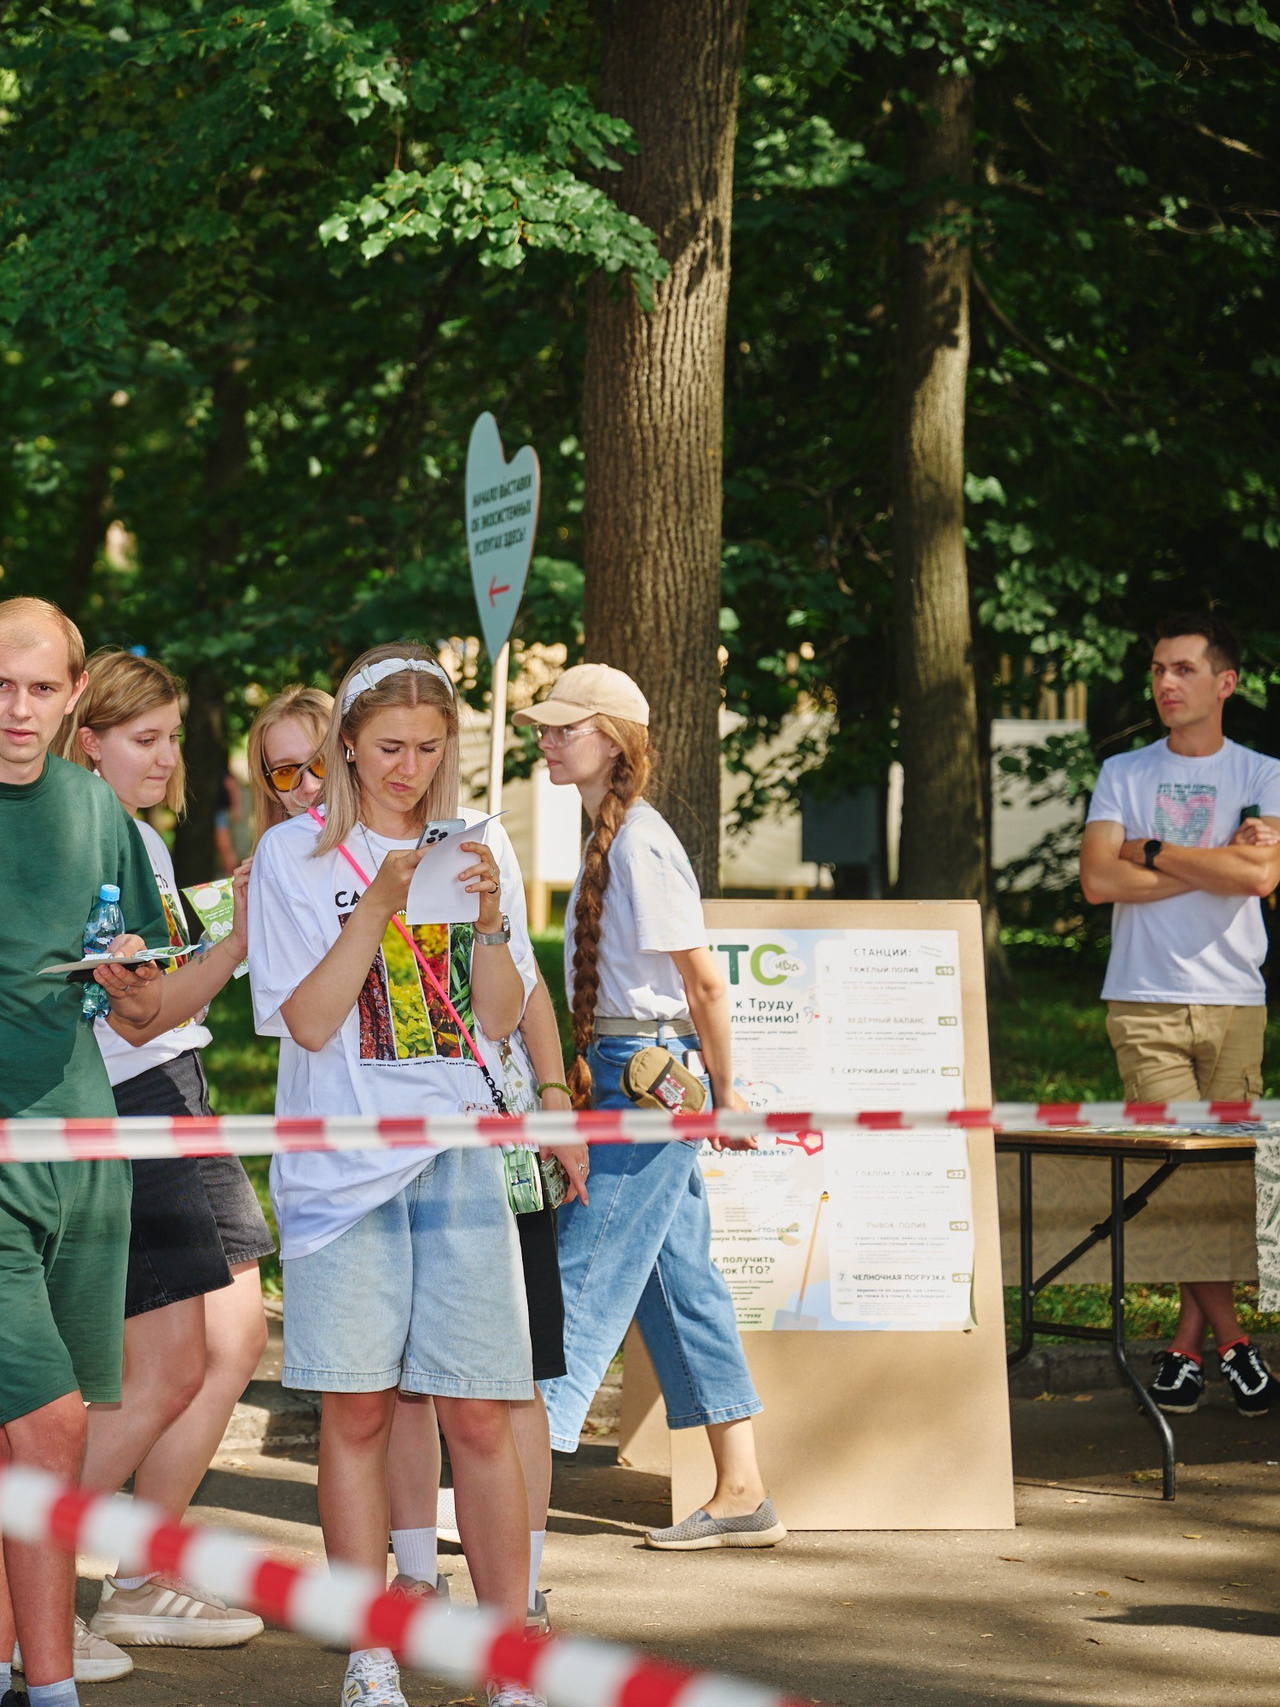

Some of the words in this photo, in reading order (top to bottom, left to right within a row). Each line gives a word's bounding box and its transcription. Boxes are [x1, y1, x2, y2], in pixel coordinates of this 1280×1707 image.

[853, 948, 912, 957] СТАНЦИИ:
[749, 998, 793, 1011] Труду
[731, 1013, 799, 1023] ленению!
[719, 1148, 794, 1158] участвовать?
[723, 1256, 775, 1265] получить
[741, 1265, 771, 1275] ГТО?
